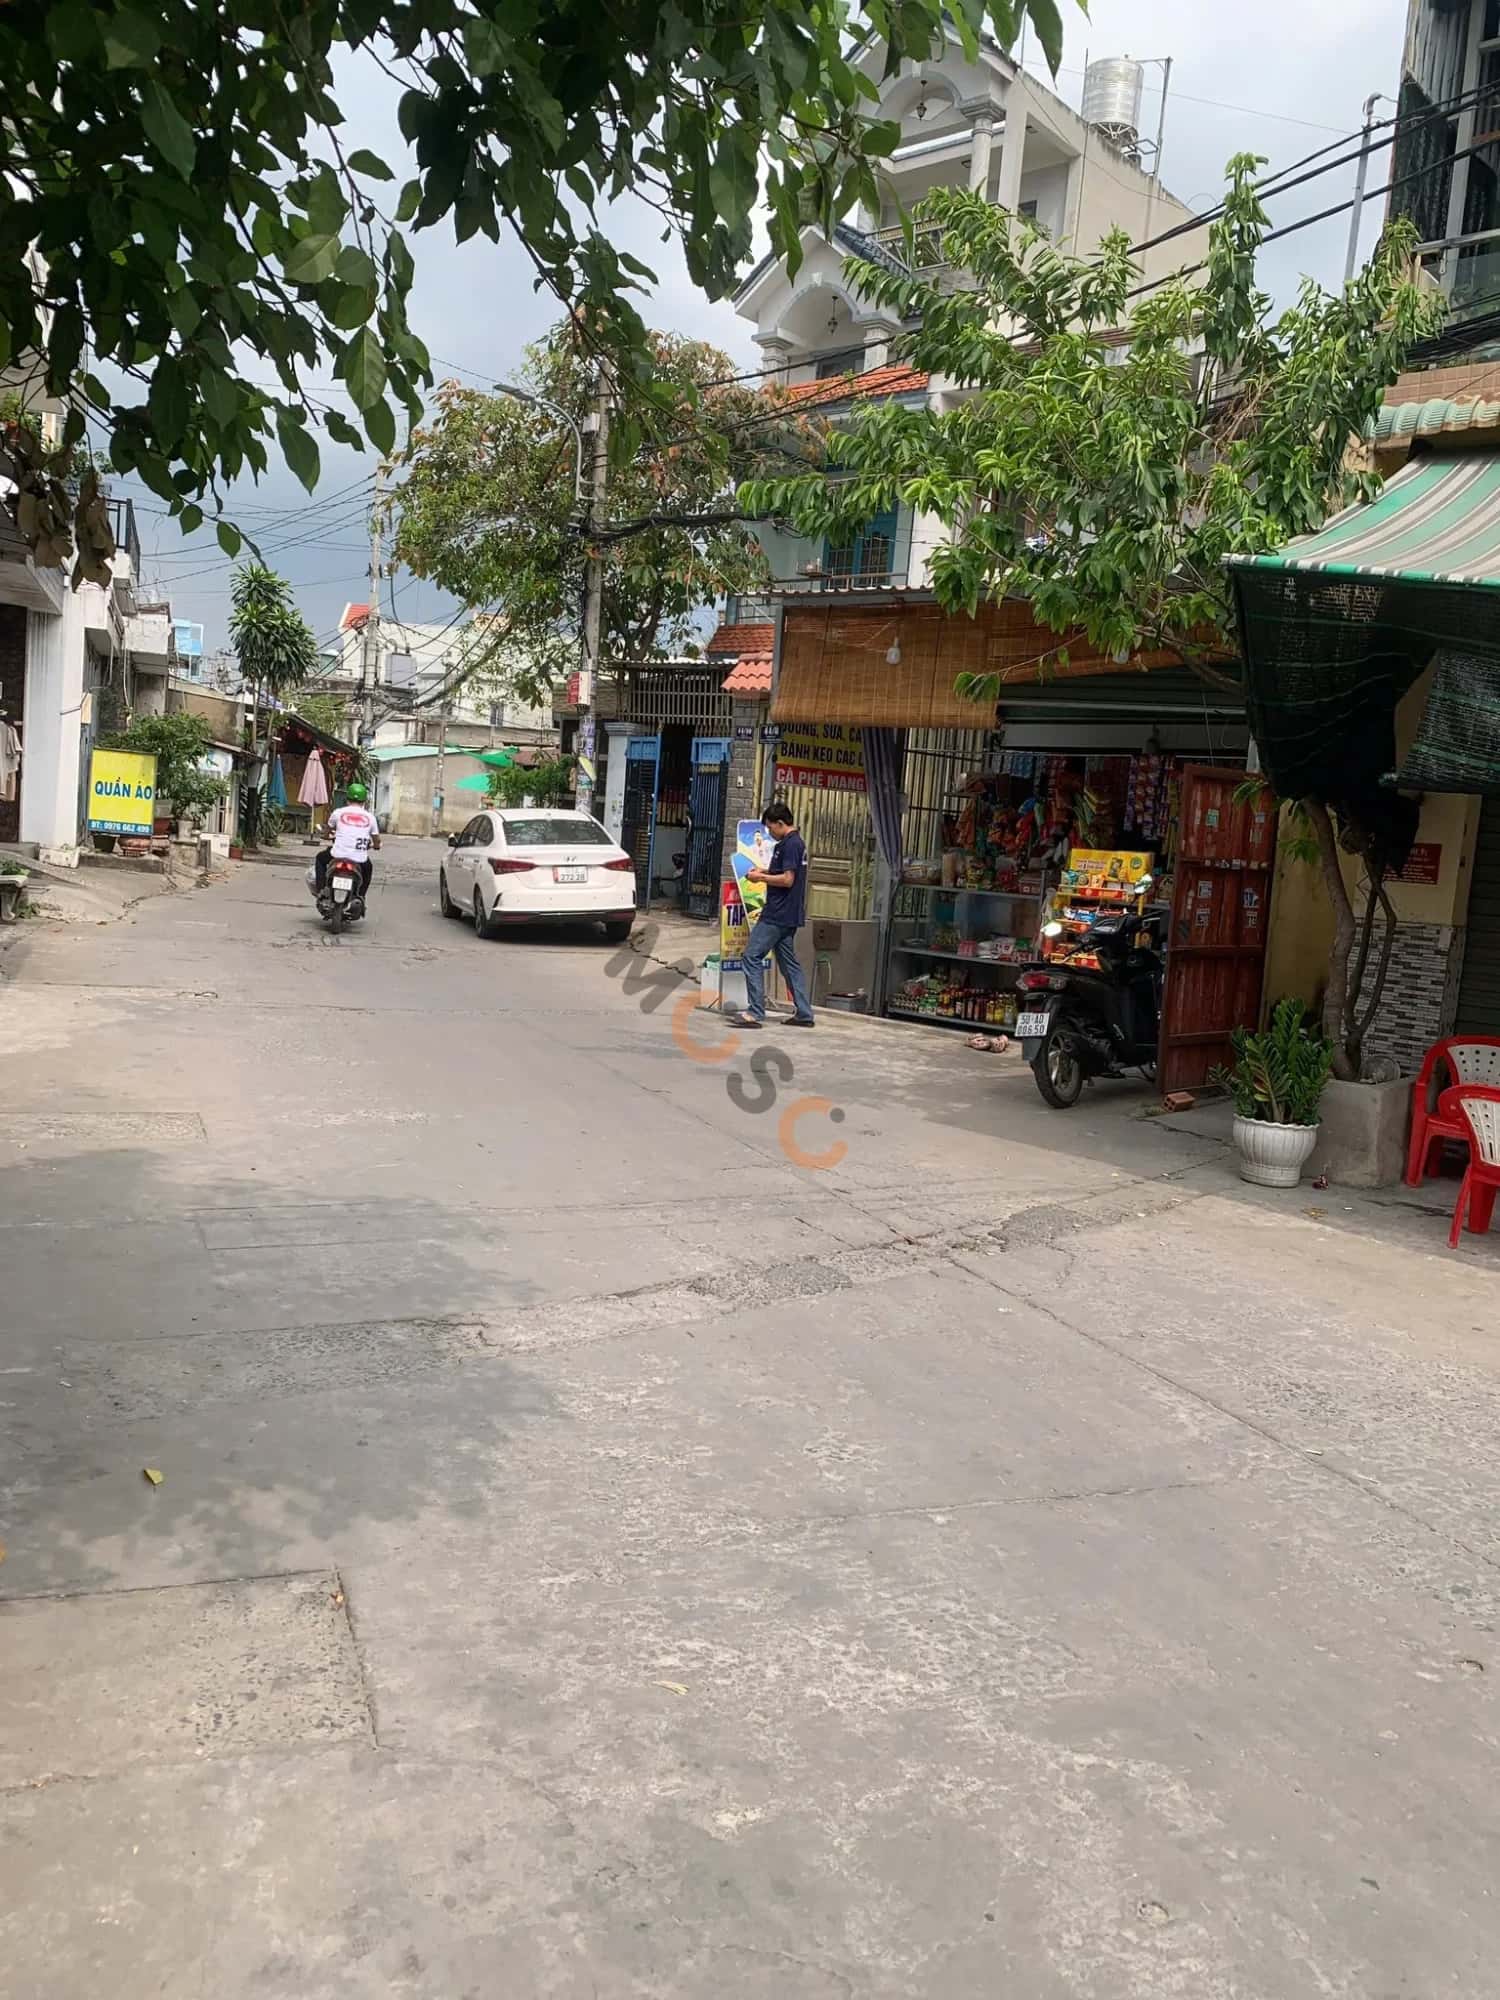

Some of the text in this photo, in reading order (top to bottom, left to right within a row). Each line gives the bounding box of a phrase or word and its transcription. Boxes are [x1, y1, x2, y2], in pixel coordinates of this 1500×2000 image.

[781, 740, 810, 760] BÁNH
[813, 745, 833, 765] KẸO
[135, 780, 153, 800] ÁO
[776, 767, 864, 791] CÀ PHÊ MANG
